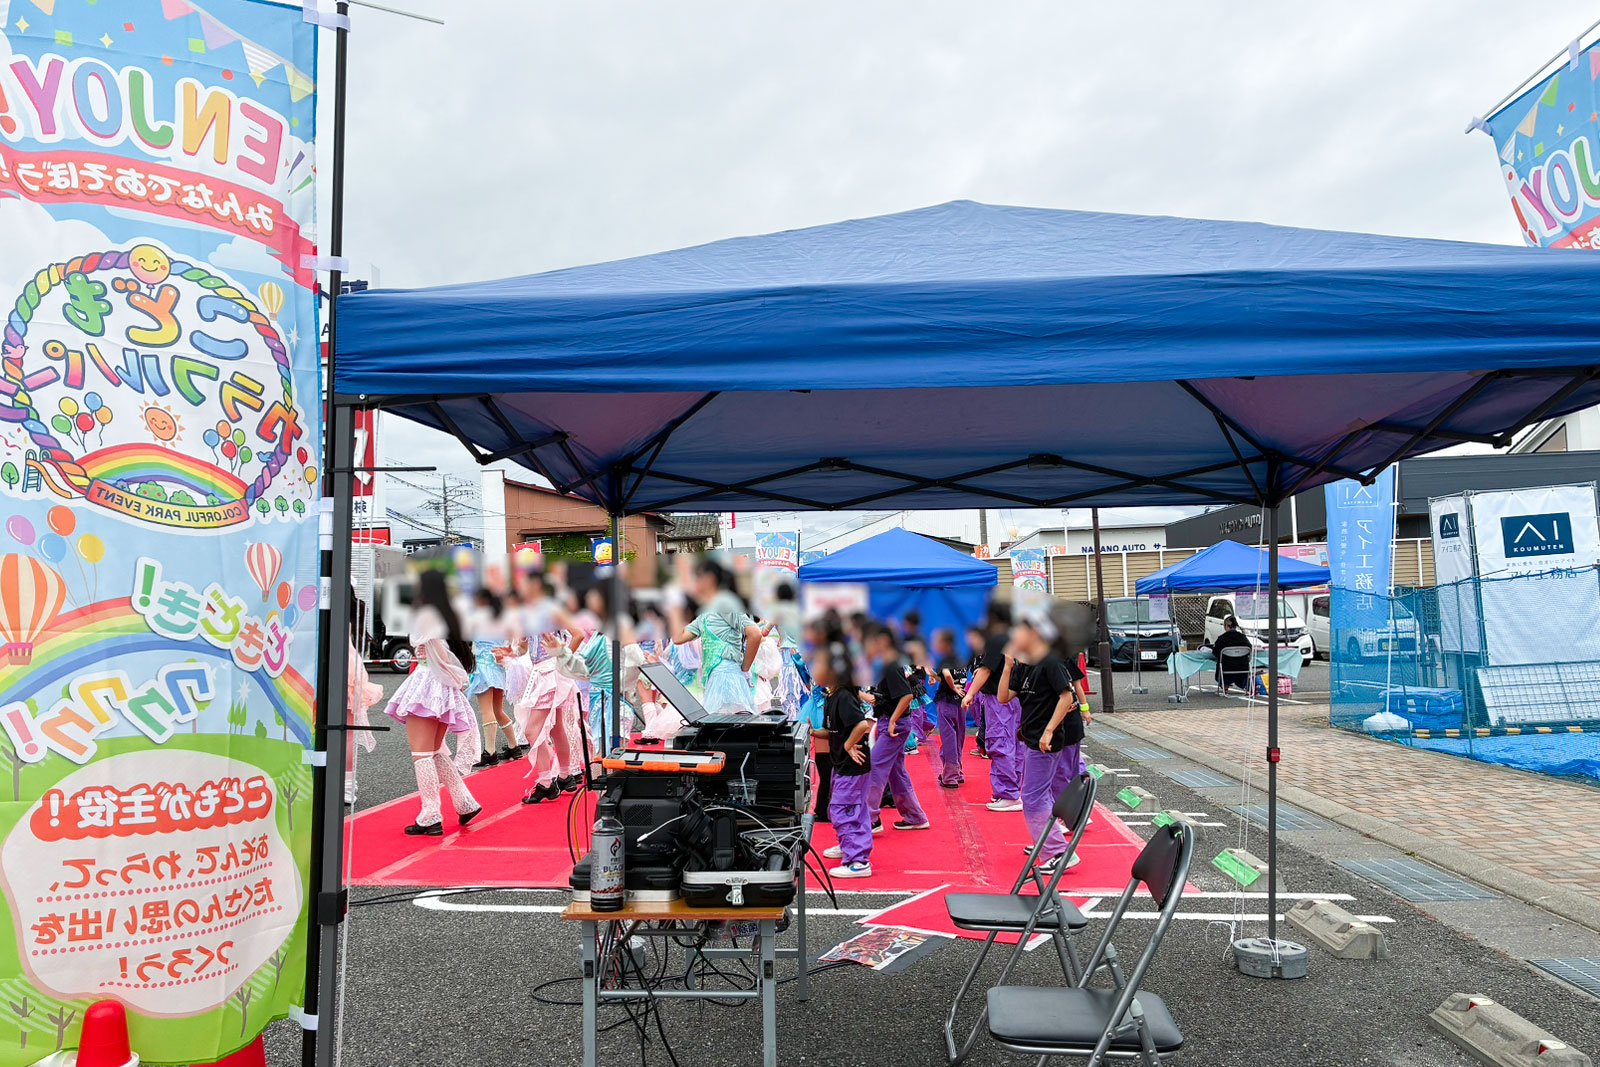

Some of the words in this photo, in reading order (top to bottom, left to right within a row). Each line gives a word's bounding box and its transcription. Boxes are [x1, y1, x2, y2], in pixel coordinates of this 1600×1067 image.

[1244, 513, 1262, 528] AUTO
[1514, 520, 1559, 544] AI
[1081, 545, 1121, 554] NAANO
[1121, 543, 1146, 552] AUTO
[1513, 544, 1564, 552] KOUMUTEN
[1507, 565, 1577, 582] アイ工務店
